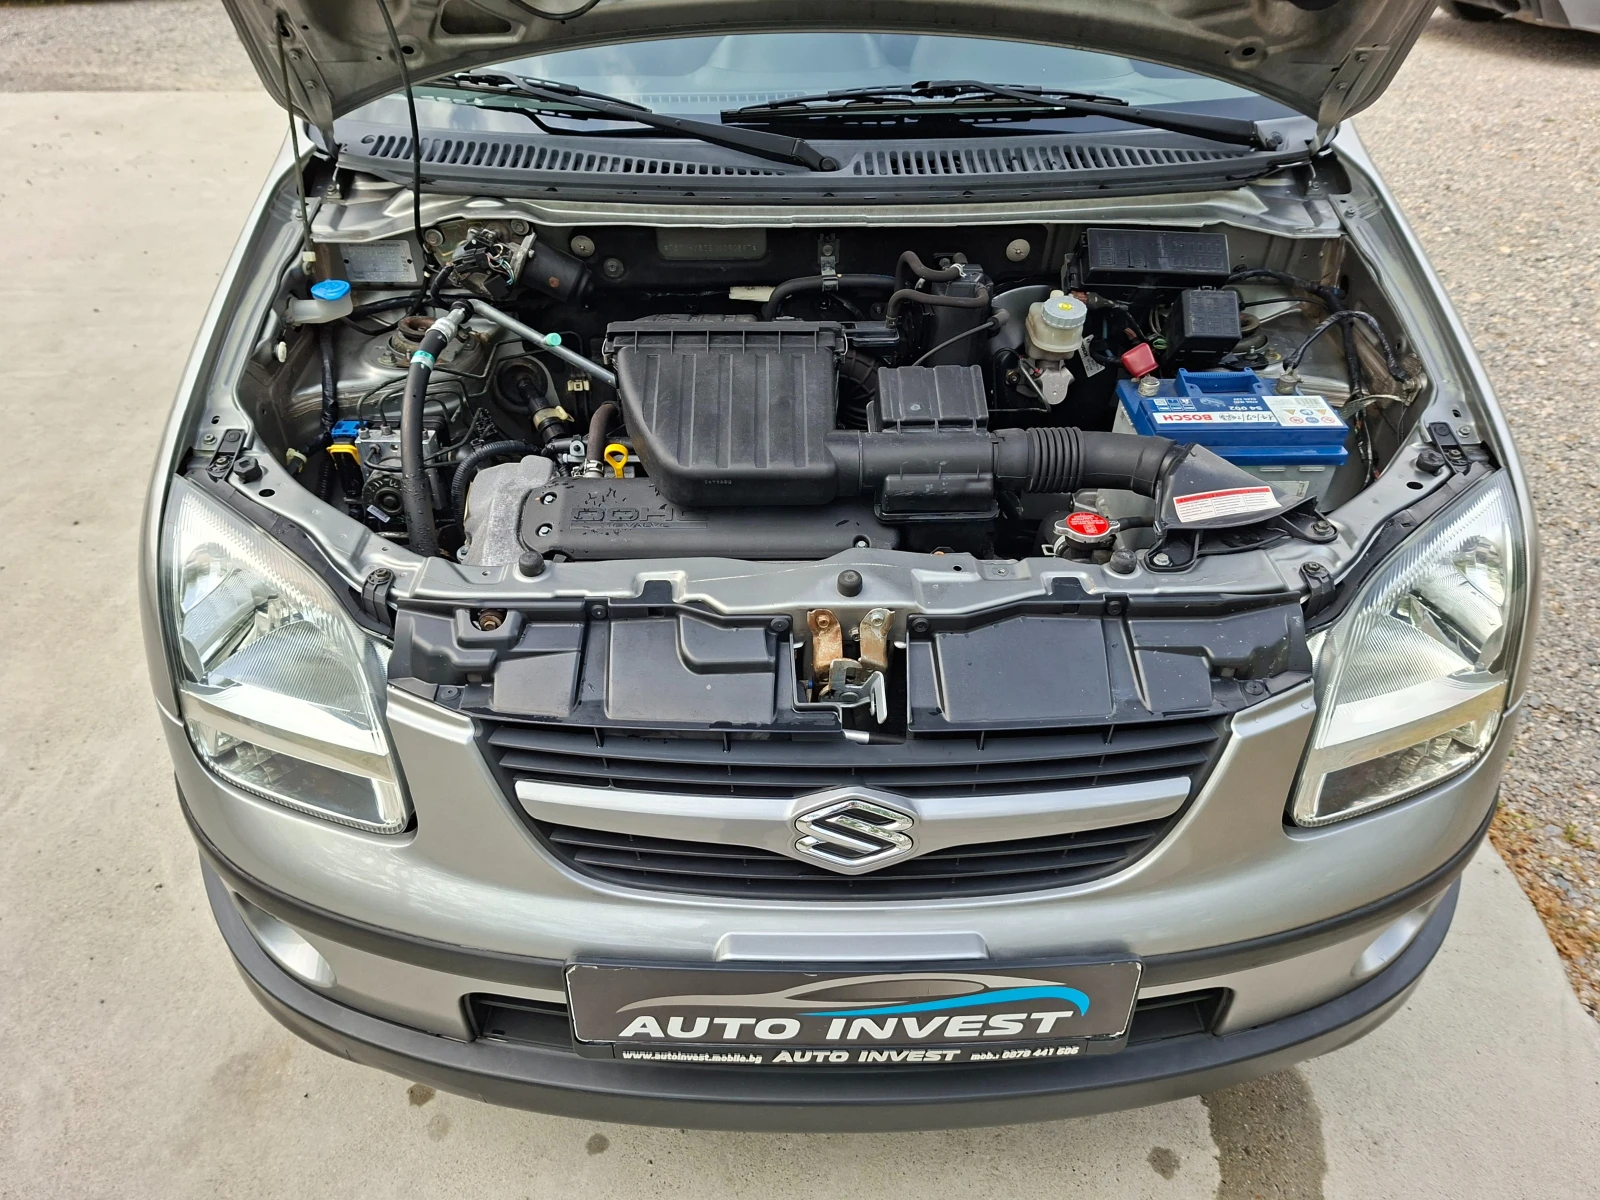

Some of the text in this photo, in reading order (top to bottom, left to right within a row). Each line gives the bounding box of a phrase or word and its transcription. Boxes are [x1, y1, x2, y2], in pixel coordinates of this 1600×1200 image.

[571, 507, 708, 521] DOHC
[618, 1011, 1074, 1040] AUTO INVEST
[622, 1050, 763, 1064] www.autoinvest.mobile.bg
[772, 1049, 850, 1063] AUTO
[858, 1049, 961, 1063] INVEST
[1032, 1047, 1054, 1057] 441
